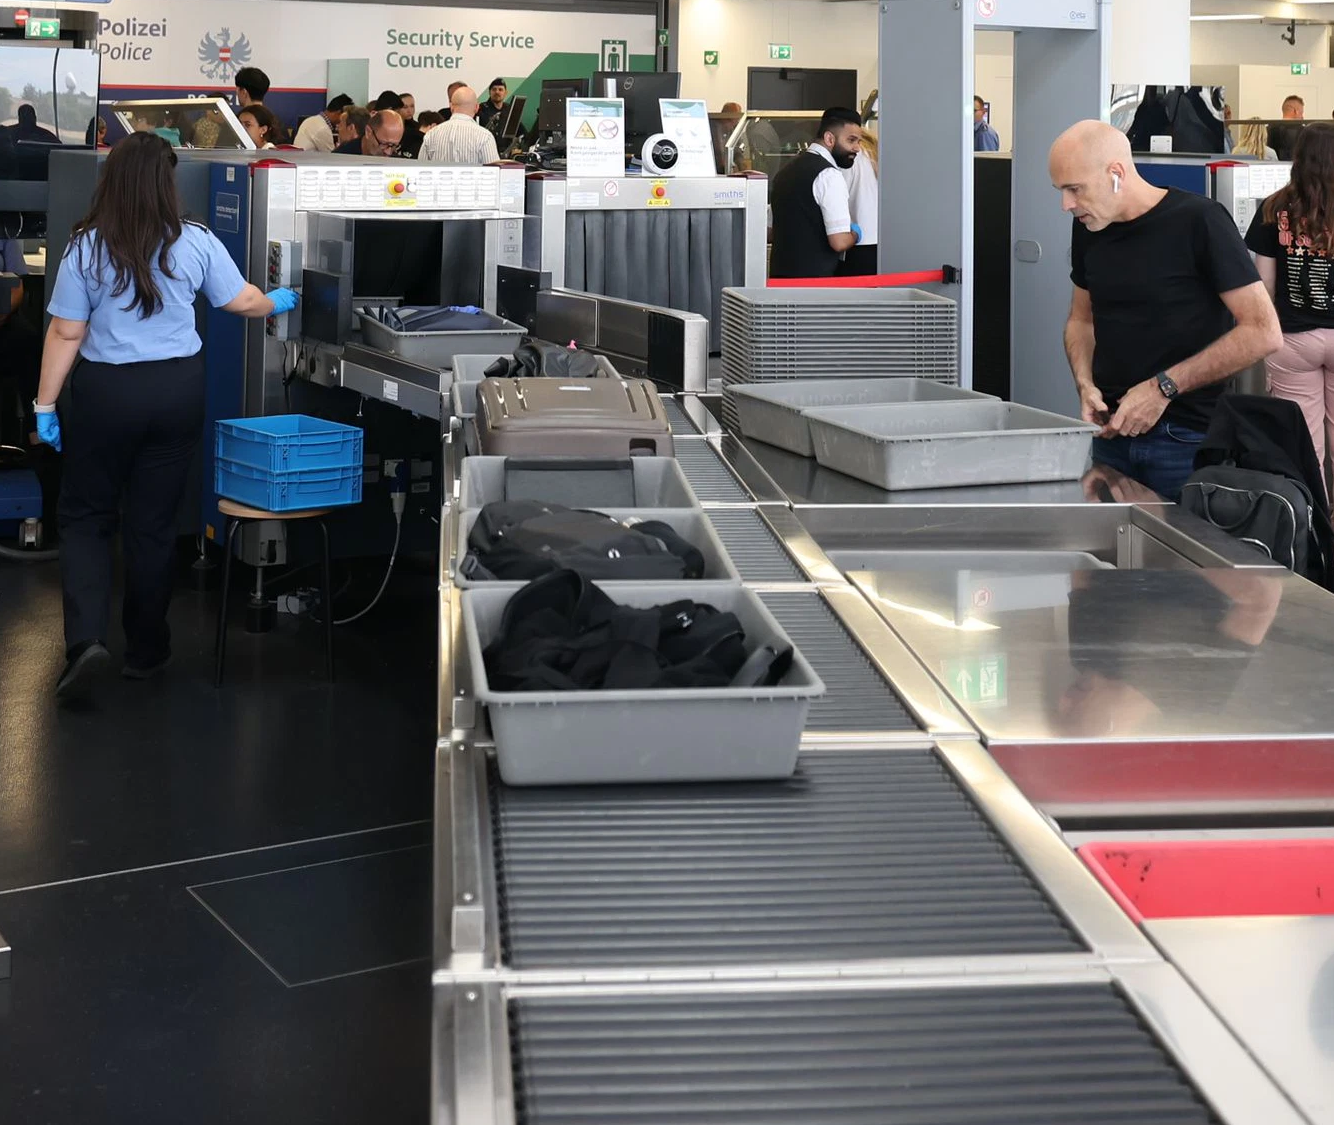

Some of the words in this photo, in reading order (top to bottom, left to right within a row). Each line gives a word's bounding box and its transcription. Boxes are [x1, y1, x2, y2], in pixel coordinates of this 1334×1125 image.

[98, 18, 167, 37] Polizei
[386, 28, 464, 51] Security
[469, 31, 535, 49] Service
[98, 42, 152, 61] Police
[386, 51, 463, 69] Counter
[714, 190, 744, 199] smiths
